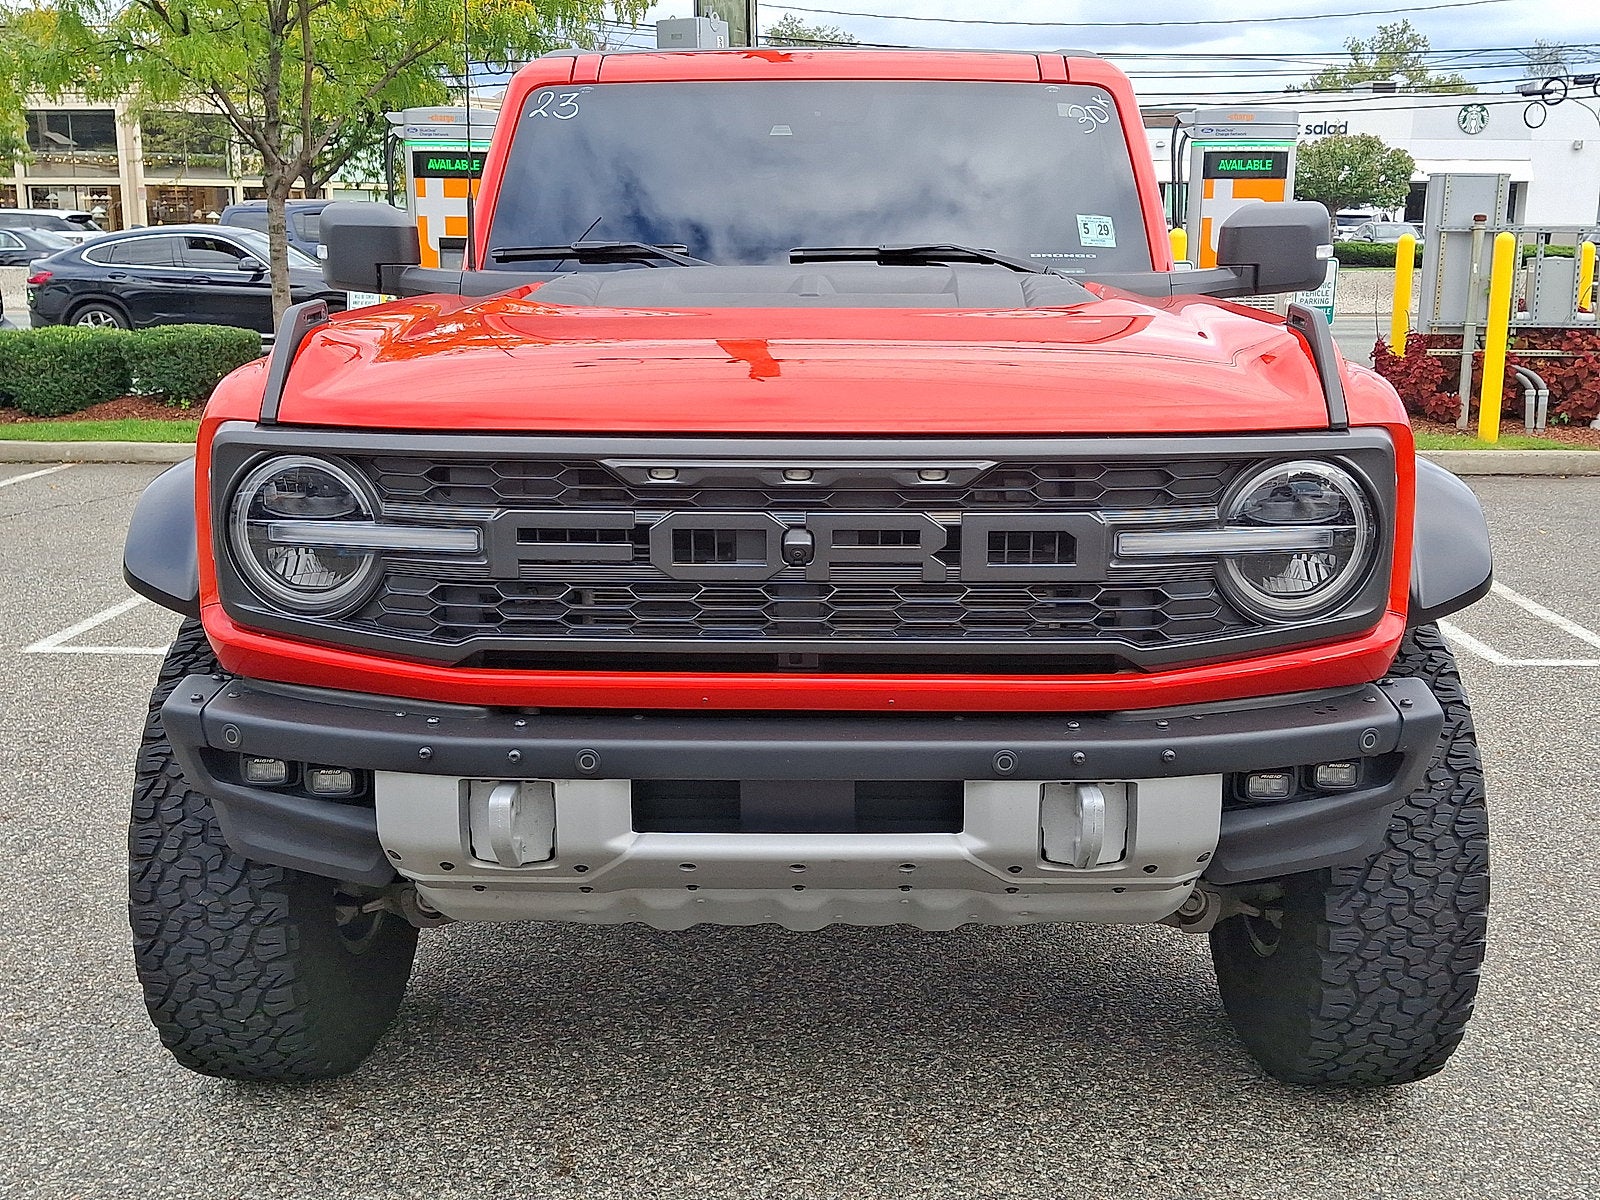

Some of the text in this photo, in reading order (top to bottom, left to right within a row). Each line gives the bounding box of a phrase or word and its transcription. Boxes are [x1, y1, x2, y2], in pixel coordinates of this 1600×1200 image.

[528, 91, 579, 119] 23
[1305, 121, 1348, 135] salad
[1218, 160, 1273, 170] AVAILABLE
[1083, 223, 1110, 236] 5 29
[491, 510, 1108, 582] FORD
